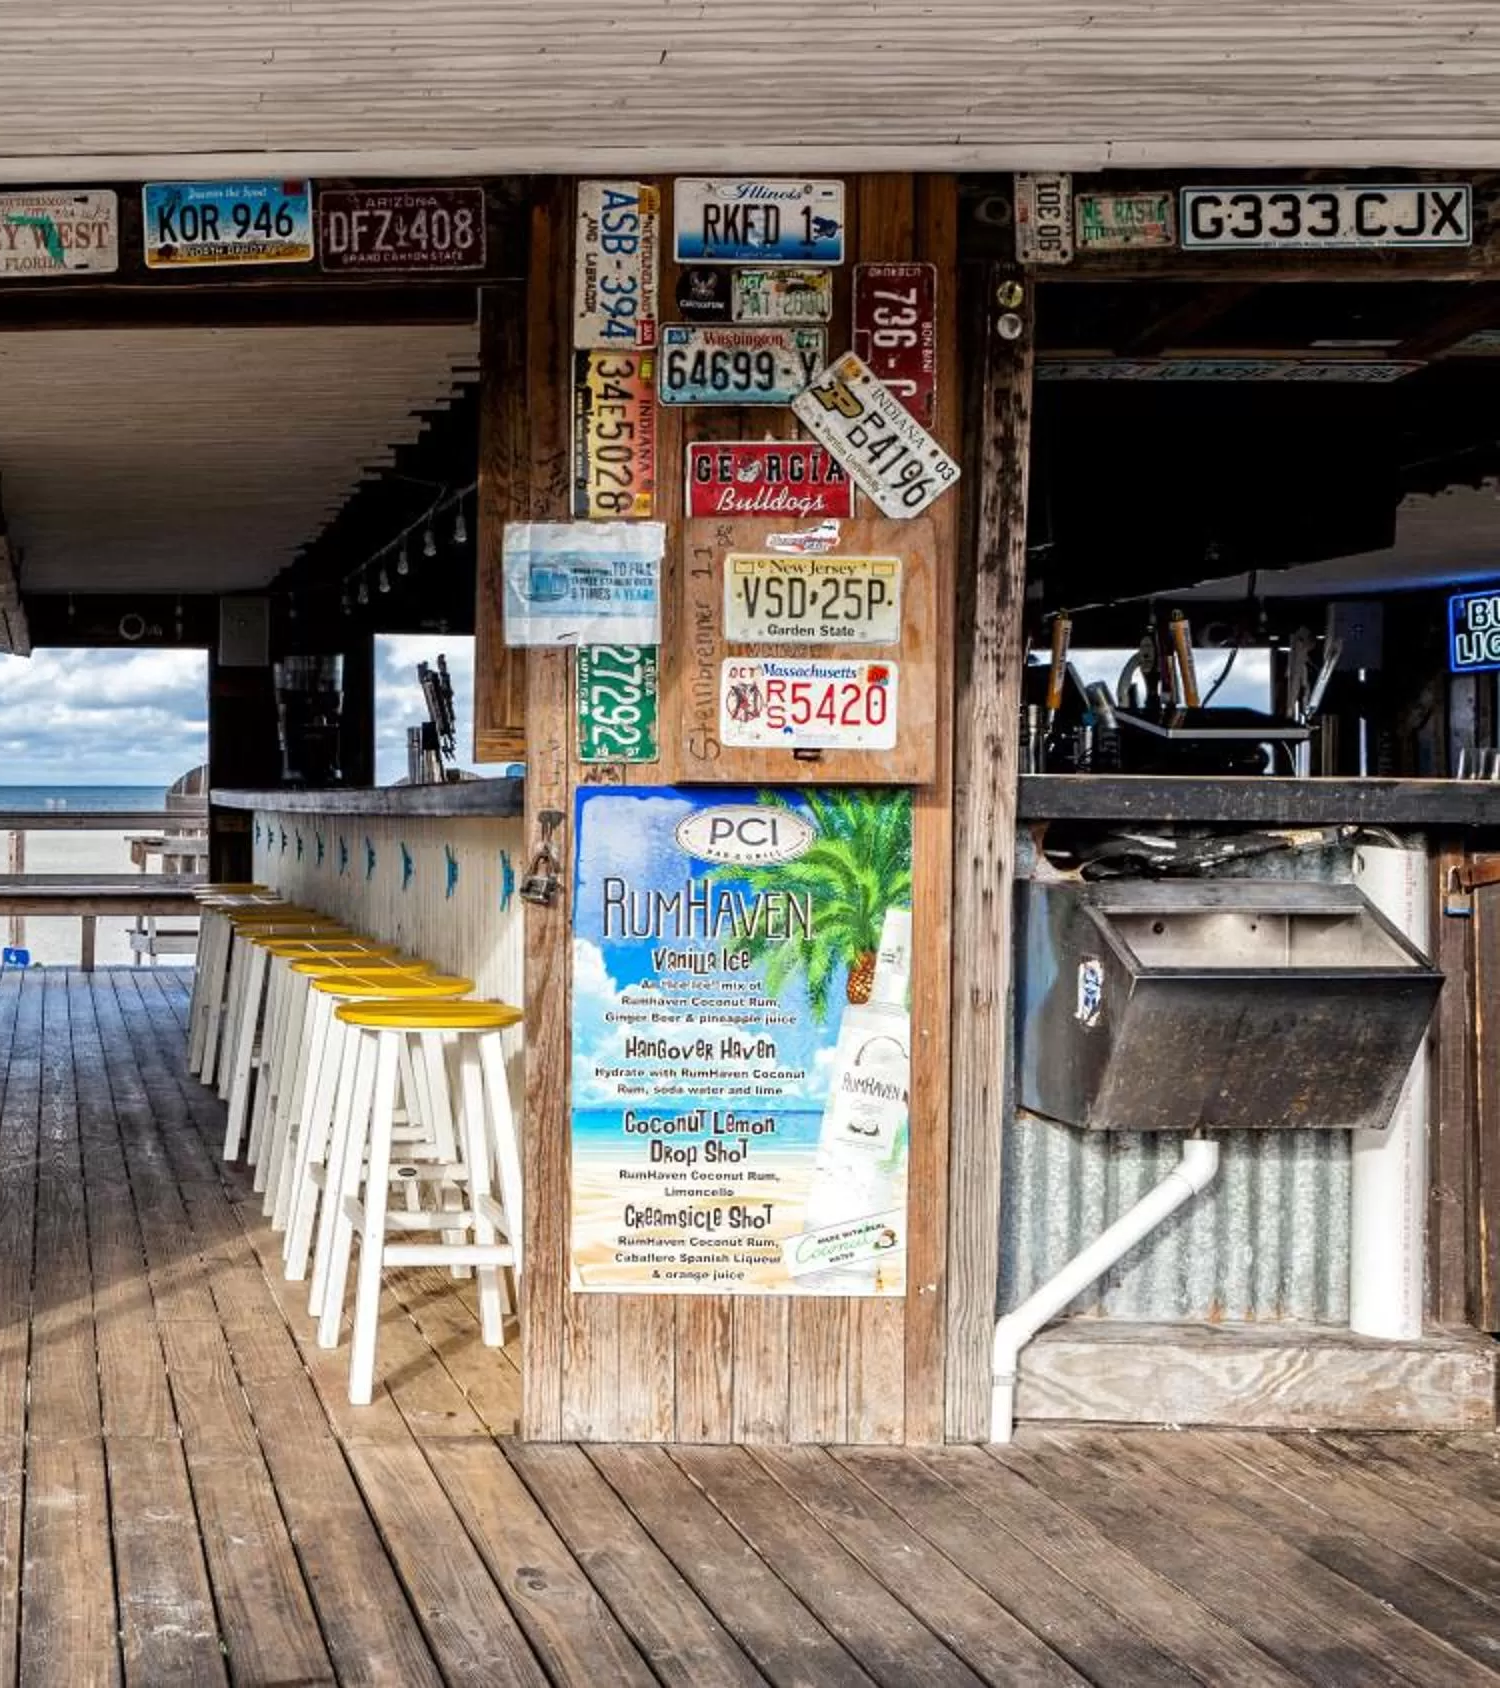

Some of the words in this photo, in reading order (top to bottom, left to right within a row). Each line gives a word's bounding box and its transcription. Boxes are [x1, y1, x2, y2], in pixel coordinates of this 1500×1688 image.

[734, 182, 802, 200] Illinois
[365, 195, 439, 209] ARIZONA
[157, 203, 219, 242] KOR
[232, 202, 293, 239] 946
[1190, 193, 1339, 240] G333
[1355, 190, 1464, 237] CJX
[33, 221, 109, 250] WEST
[328, 209, 395, 255] DFZ
[409, 208, 475, 251] 408
[5, 256, 68, 271] FLORIDA
[601, 189, 641, 338] ASB-394
[702, 332, 786, 347] Washington
[871, 388, 926, 450] INDIANA
[639, 400, 651, 472] INDIANA
[695, 453, 846, 484] GERGIA
[868, 432, 936, 508] 4196
[716, 487, 826, 513] Bulldogs
[769, 560, 804, 573] New
[807, 560, 859, 576] Jersey
[742, 577, 807, 619] VSD
[821, 577, 886, 622] 25P
[767, 625, 815, 637] Garden
[819, 625, 856, 638] State
[729, 666, 757, 679] OCT
[761, 662, 858, 679] Massachusetts
[791, 683, 888, 726] 5420
[708, 817, 779, 847] PCI
[722, 950, 750, 973] Ice
[721, 981, 746, 991] mix
[749, 981, 762, 991] of
[691, 997, 745, 1007] Coconut
[748, 997, 781, 1008] Rum,
[604, 1012, 647, 1024] Ginger
[651, 1013, 681, 1023] Beer
[685, 1013, 695, 1023] &
[698, 1013, 762, 1025] pineapple
[765, 1014, 798, 1025] juice
[595, 1067, 645, 1079] Hydrate
[649, 1068, 677, 1077] with
[681, 1068, 749, 1078] RumHaven
[752, 1069, 806, 1079] Coconut
[617, 1085, 649, 1096] Rum,
[653, 1085, 684, 1095] soda
[687, 1085, 724, 1095] water
[728, 1085, 752, 1095] and
[755, 1085, 783, 1095] lime
[619, 1169, 687, 1181] RumHaven
[690, 1170, 744, 1181] Coconut
[747, 1171, 781, 1182] Rum,
[664, 1187, 735, 1197] Limoncello
[617, 1236, 686, 1247] RumHaven
[689, 1237, 743, 1247] Coconut
[746, 1237, 780, 1249] Rum,
[615, 1253, 677, 1263] Caballero
[680, 1253, 729, 1265] Spanish
[733, 1254, 782, 1266] Liqueur
[651, 1269, 661, 1279] &
[665, 1271, 710, 1281] orange
[712, 1269, 745, 1281] juice
